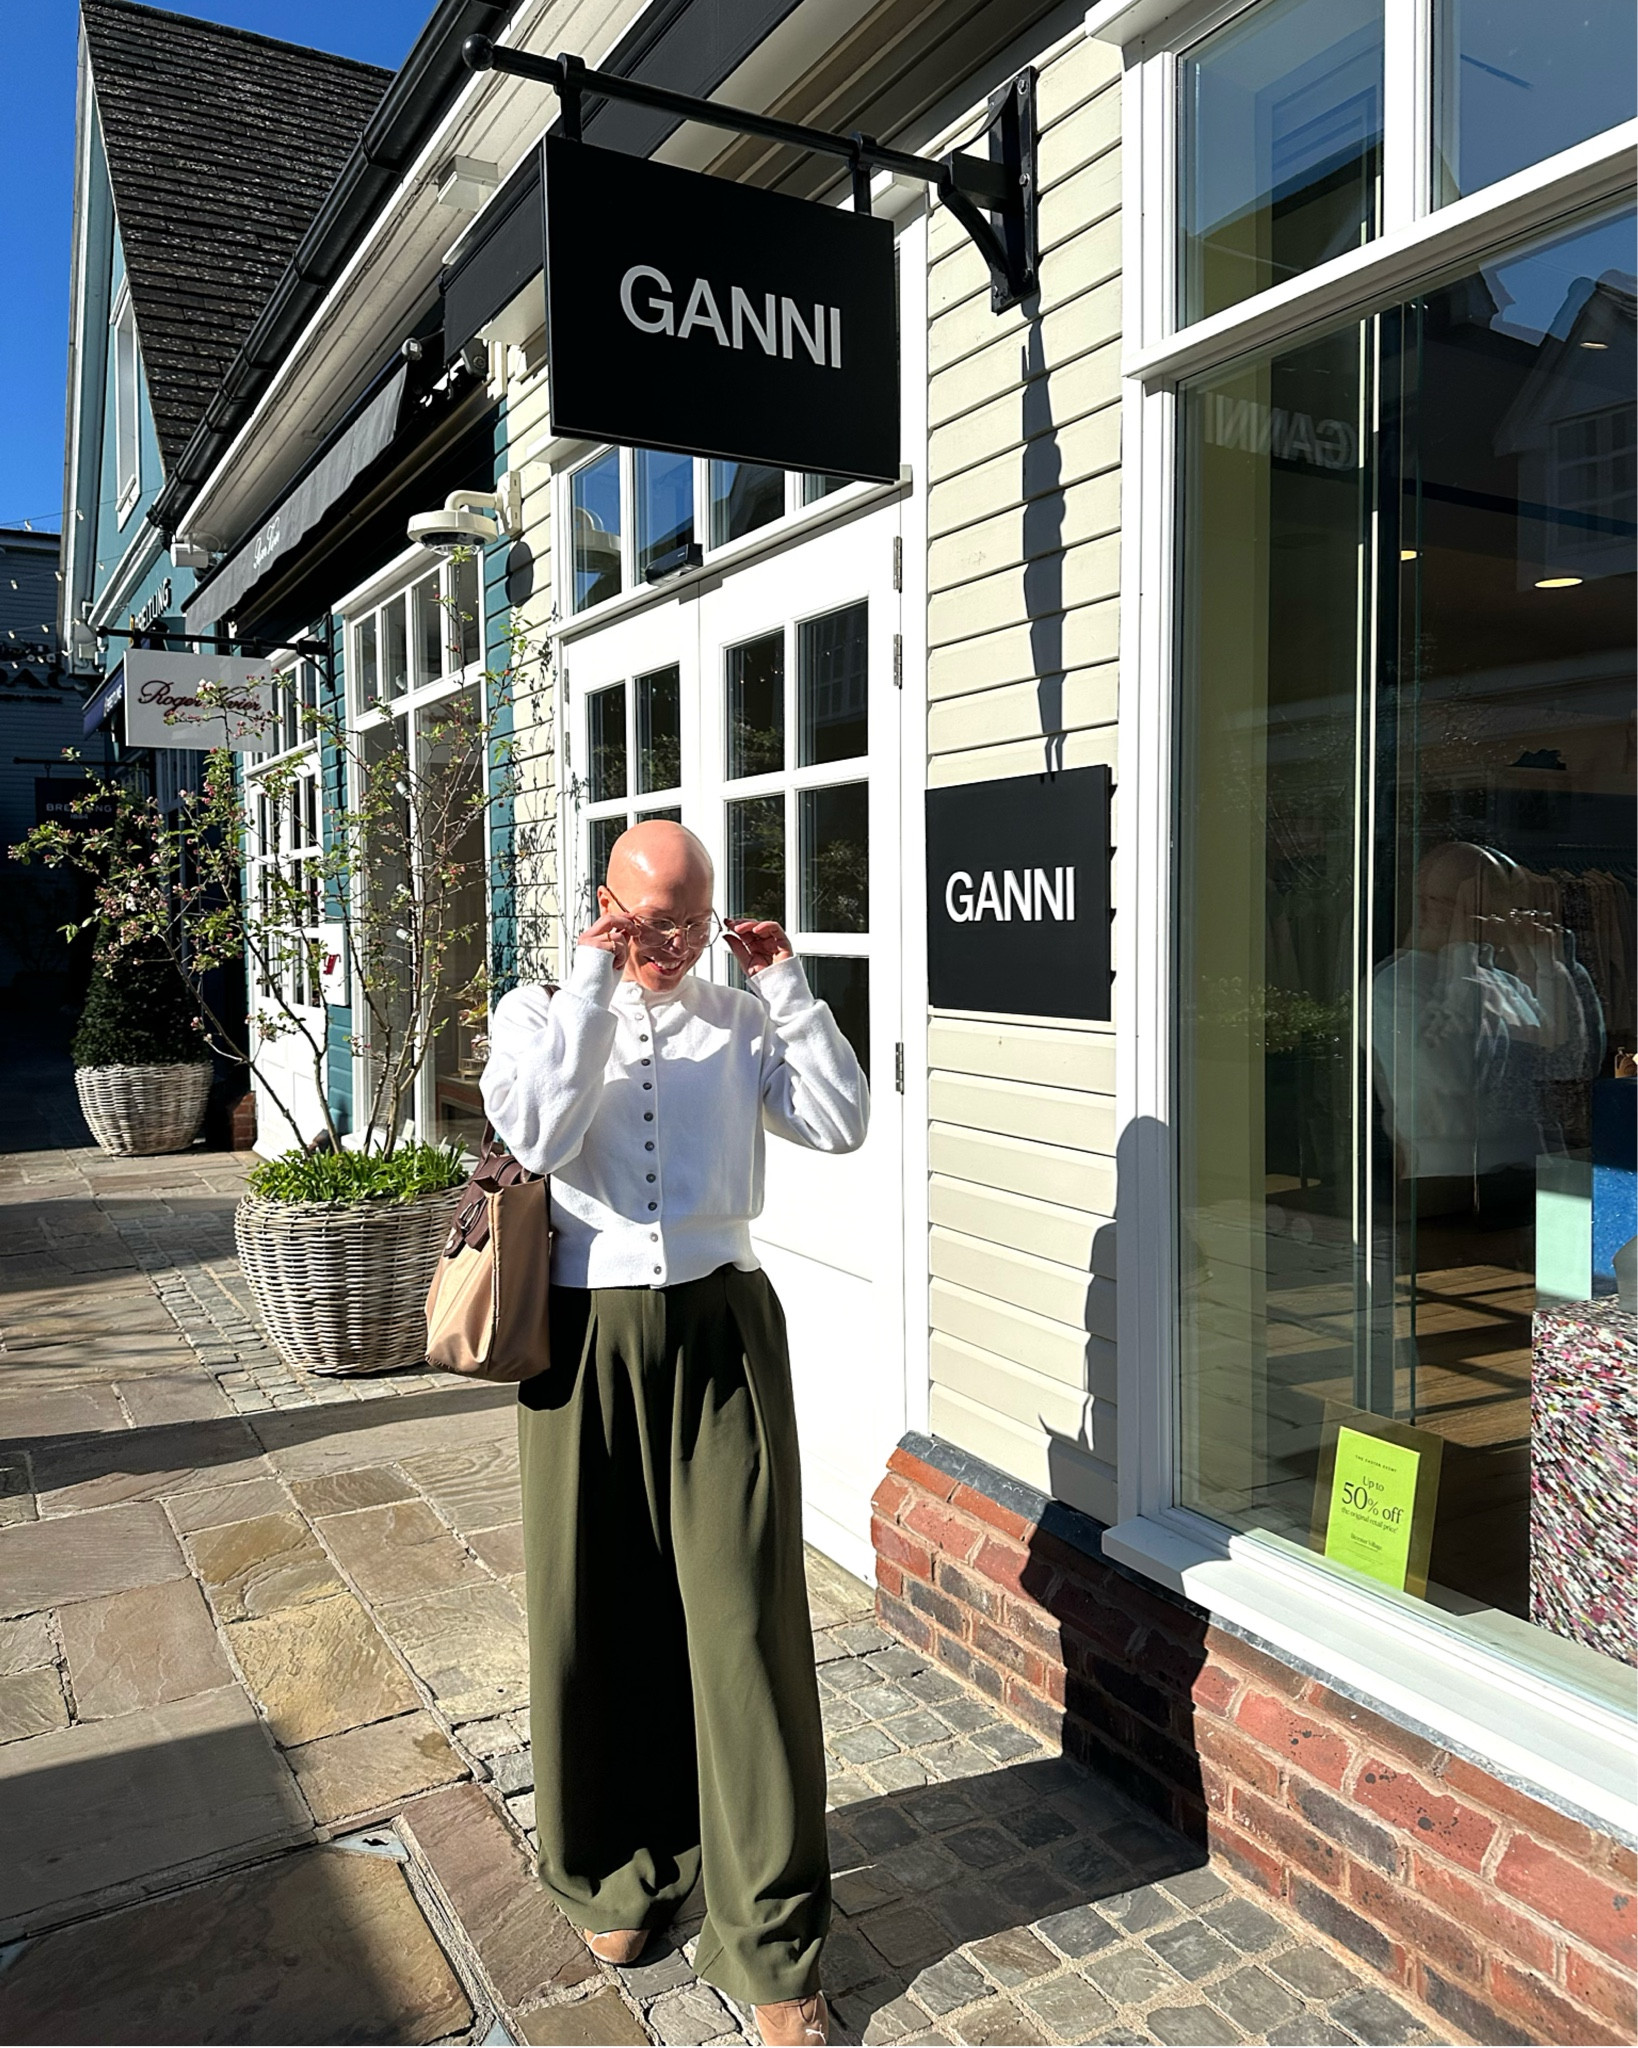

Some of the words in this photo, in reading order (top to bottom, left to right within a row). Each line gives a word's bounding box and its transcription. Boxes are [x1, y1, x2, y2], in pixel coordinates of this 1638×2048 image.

[620, 265, 842, 369] GANNI
[945, 866, 1075, 922] GANNI
[1341, 1481, 1380, 1516] 50%
[1382, 1506, 1404, 1524] off
[1362, 1476, 1376, 1490] Up
[1375, 1482, 1385, 1492] to
